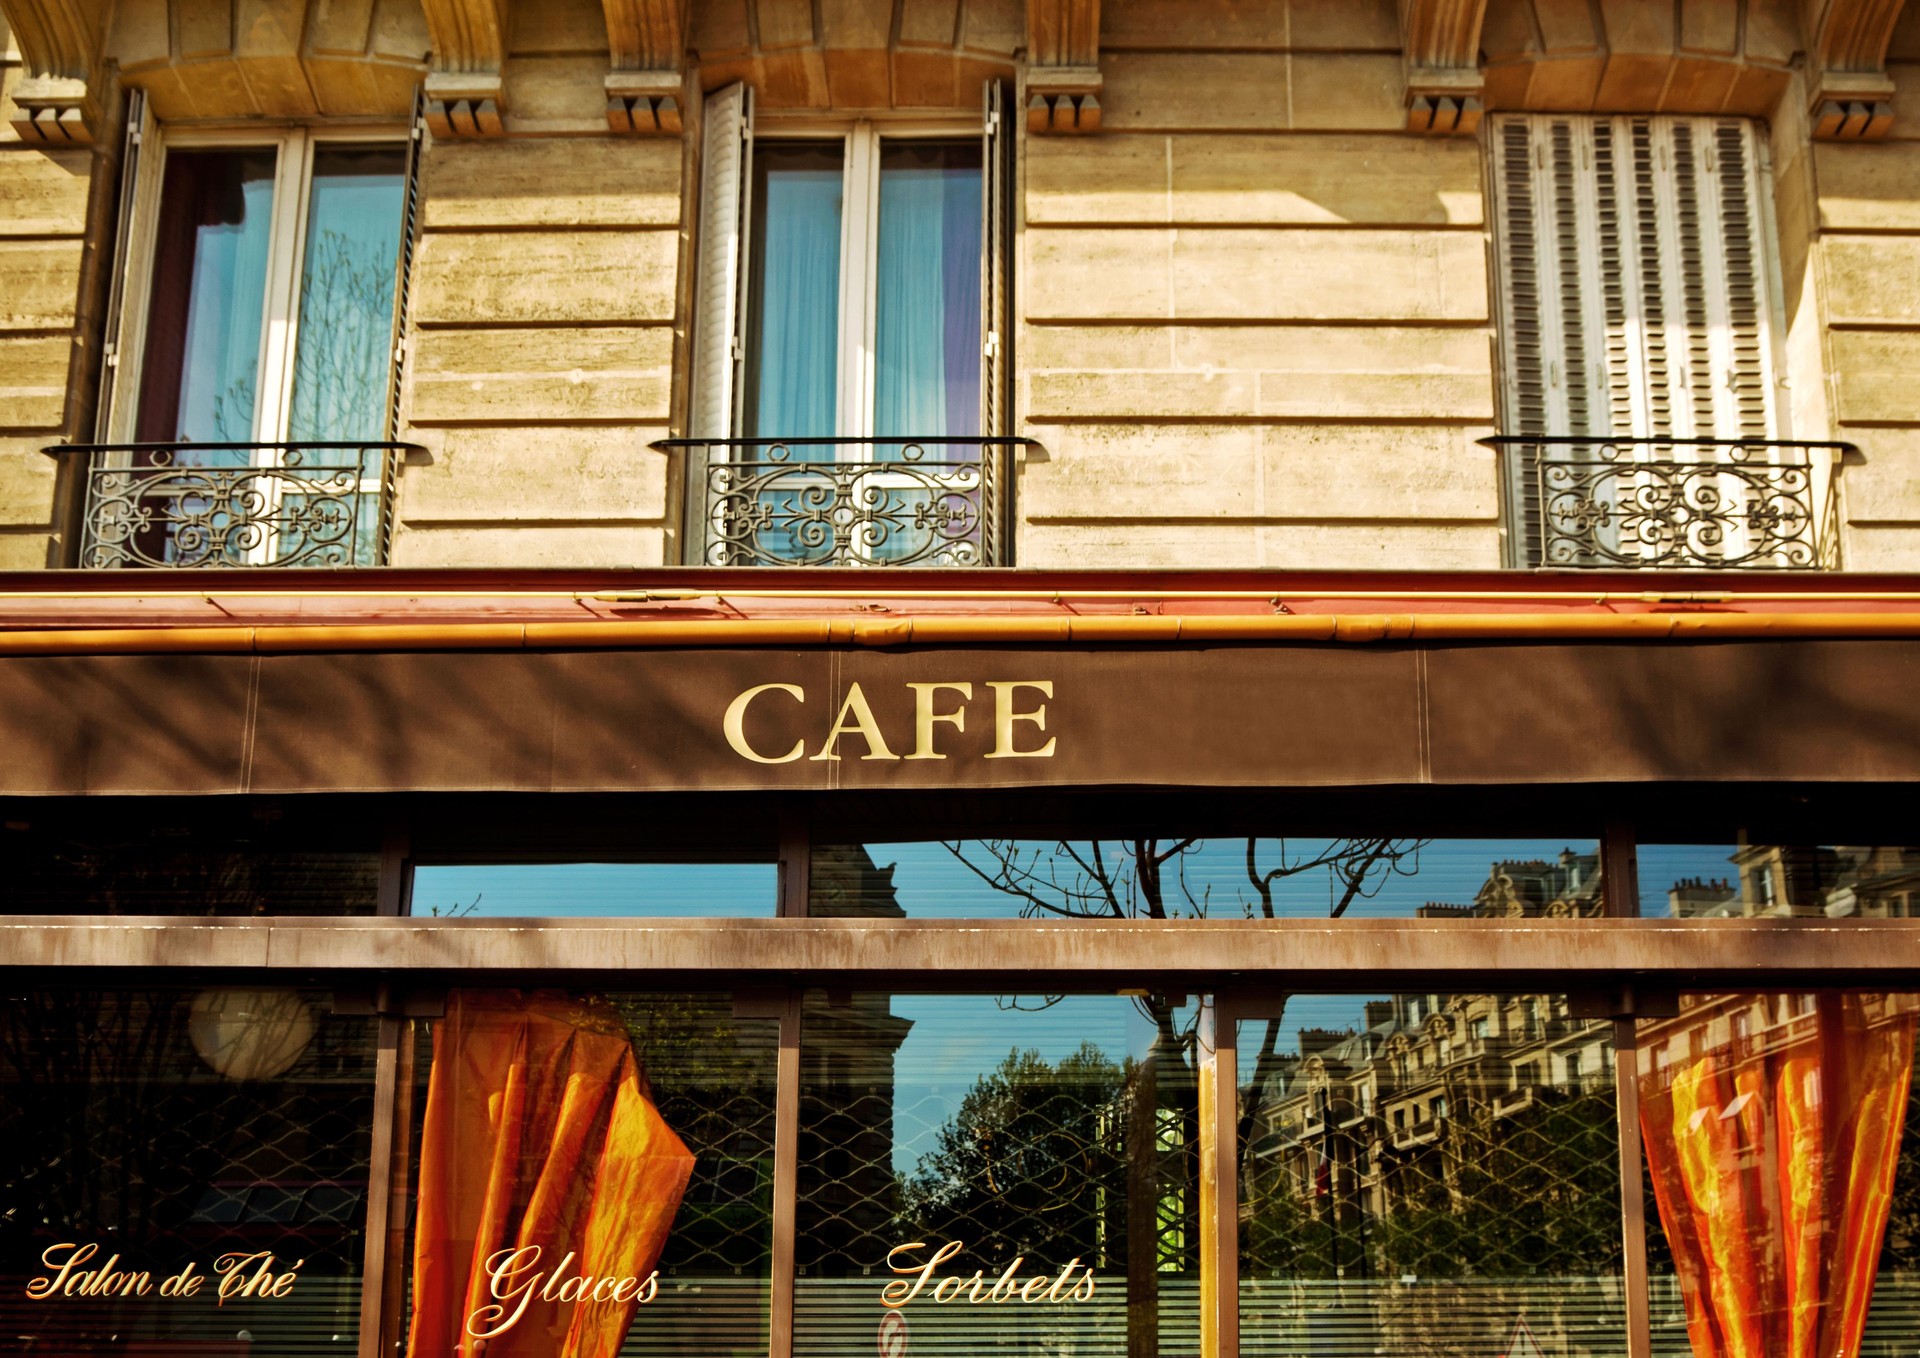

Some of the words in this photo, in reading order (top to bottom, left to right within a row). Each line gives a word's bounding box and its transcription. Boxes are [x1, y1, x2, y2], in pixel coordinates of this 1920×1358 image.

[723, 680, 1056, 764] CAFE
[25, 1242, 154, 1300] Salon
[159, 1261, 205, 1298] de
[213, 1250, 305, 1307] Thé
[466, 1245, 660, 1339] Glaces
[879, 1240, 1096, 1308] Sorbets
